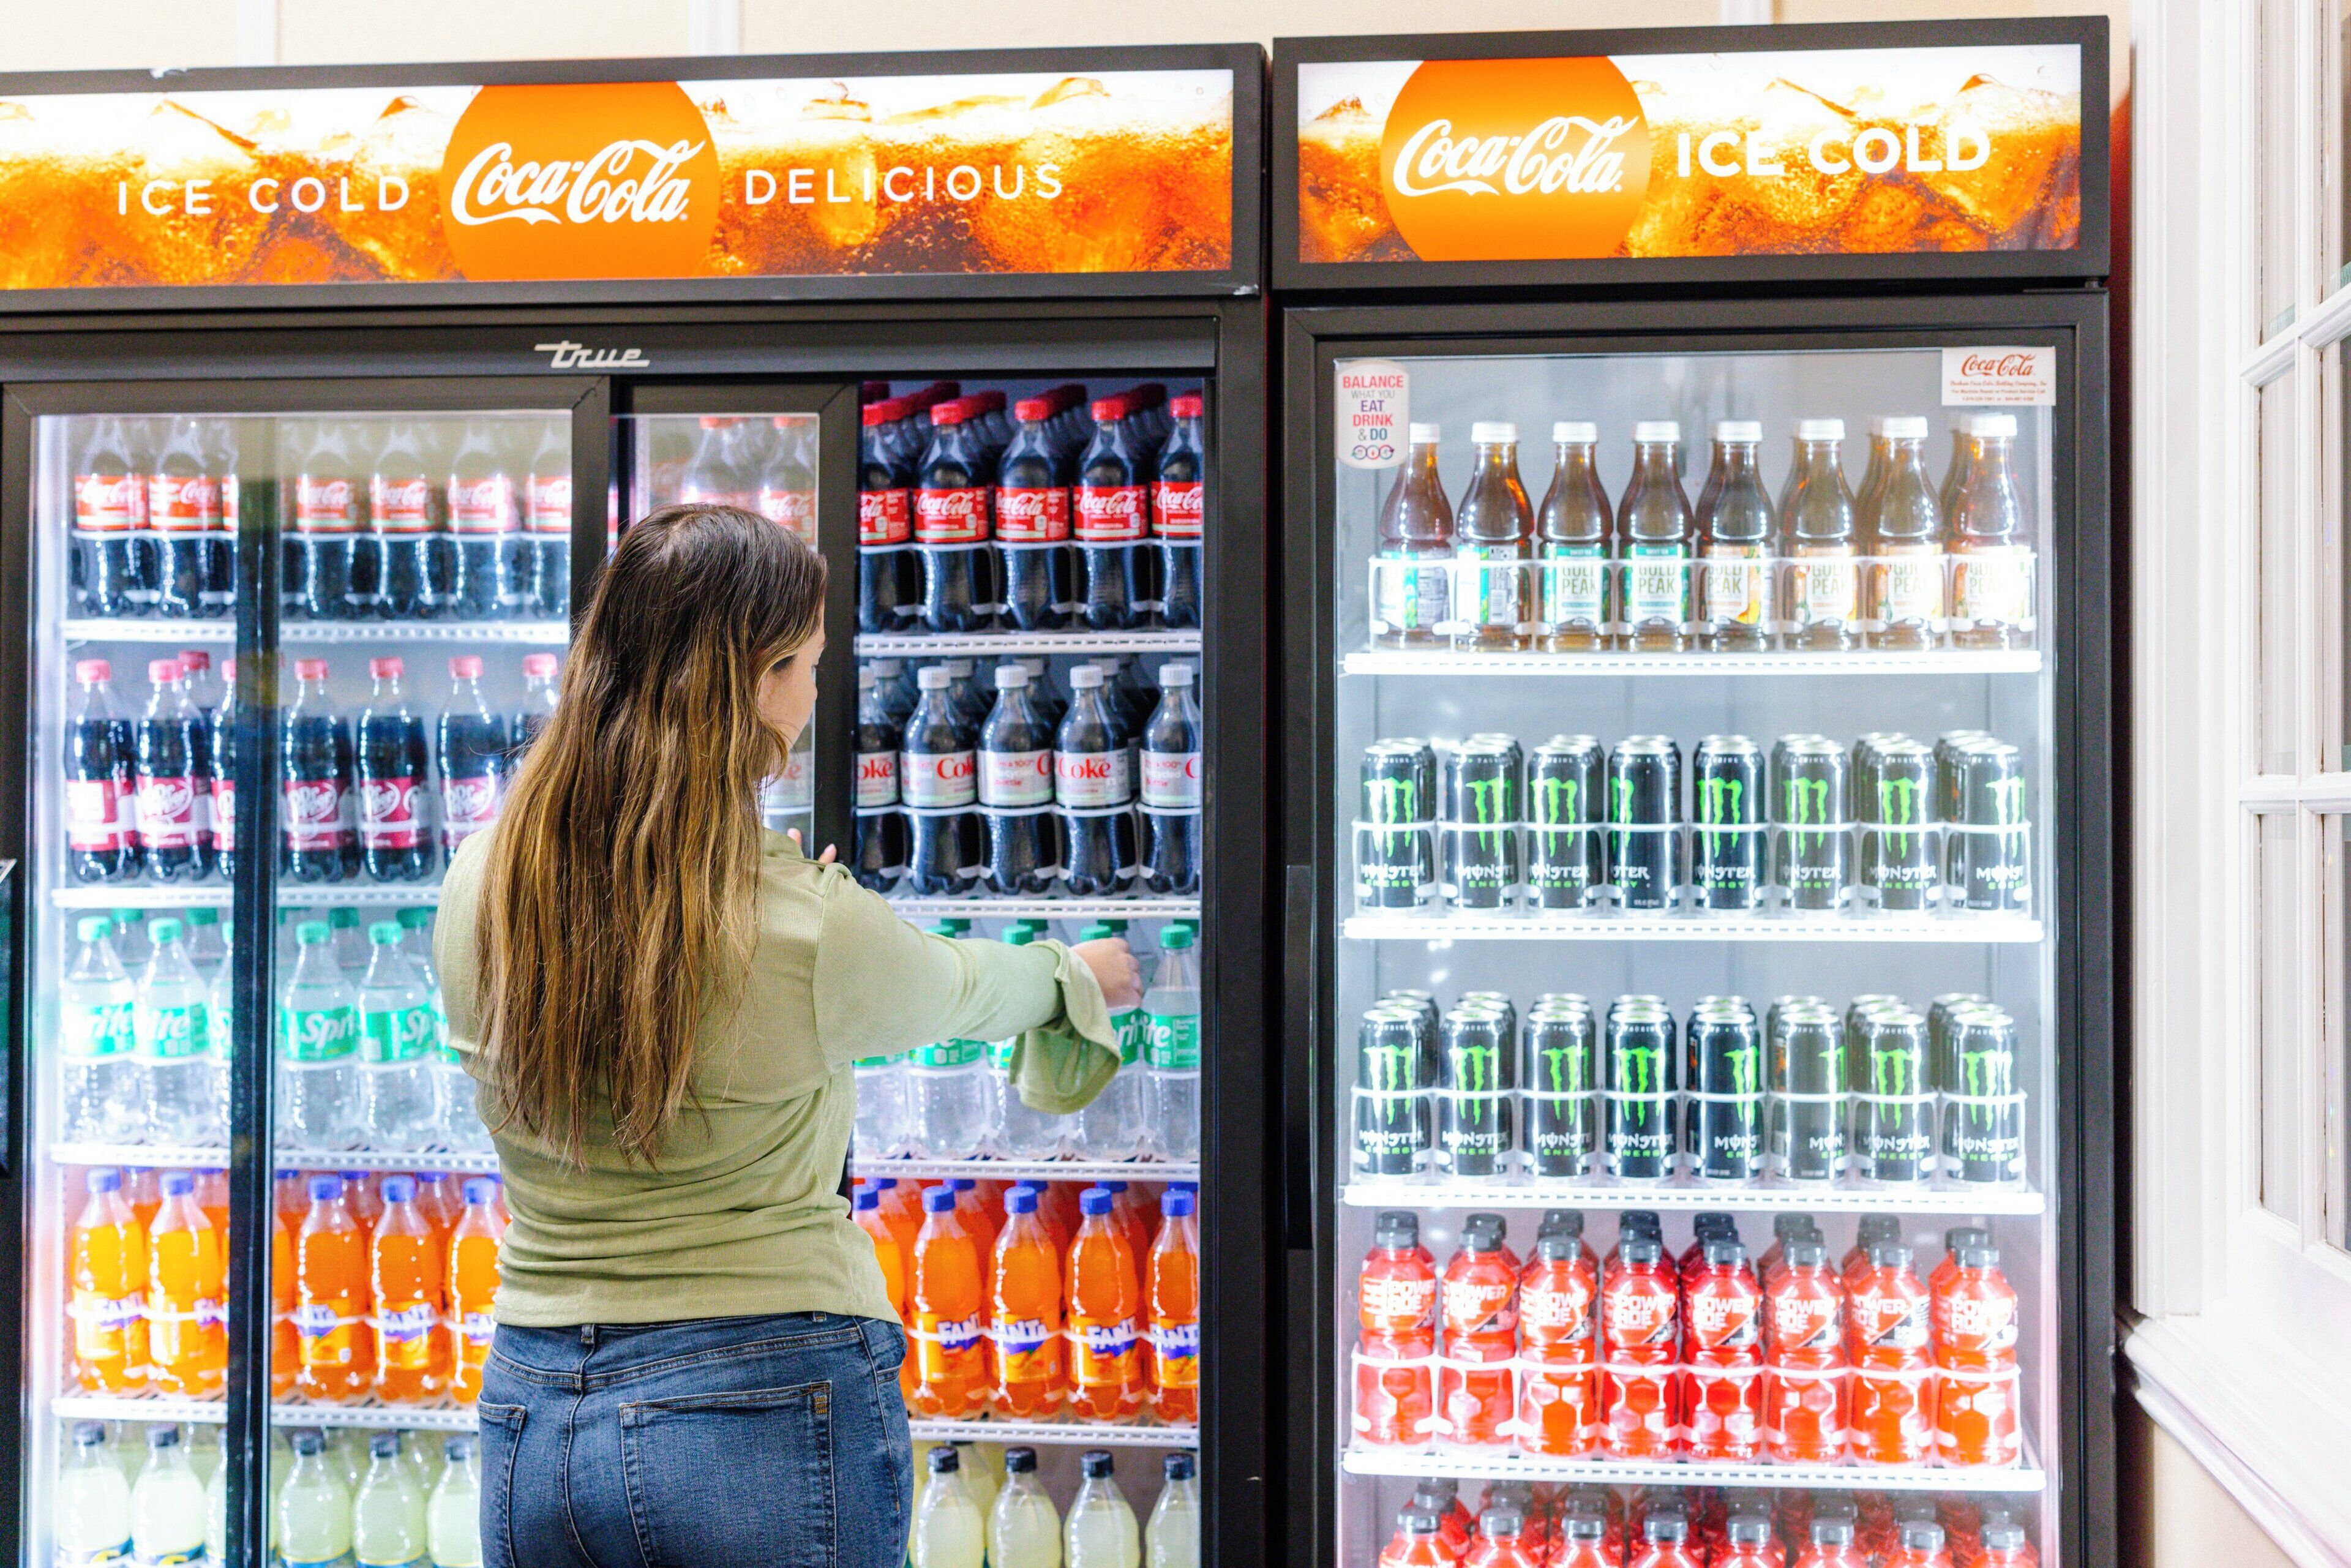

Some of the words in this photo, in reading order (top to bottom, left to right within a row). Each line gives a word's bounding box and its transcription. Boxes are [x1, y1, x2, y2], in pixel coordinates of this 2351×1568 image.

[1392, 114, 1640, 197] Coca-Cola
[1678, 127, 1786, 178] ICE
[1809, 124, 1990, 174] COLD
[451, 138, 706, 225] Coca-Cola
[744, 163, 1063, 205] DELICIOUS
[118, 179, 212, 216] ICE
[249, 175, 410, 212] COLD
[1961, 353, 2037, 377] Coca-Cola
[1343, 375, 1403, 388] BALANCE
[1351, 390, 1376, 399] WHAT
[1361, 400, 1384, 411] EAT
[1353, 415, 1393, 427] DRINK
[1358, 429, 1367, 441] &
[1370, 429, 1387, 440] DO
[1639, 577, 1674, 593] PEAK
[1614, 1294, 1676, 1310] POWR
